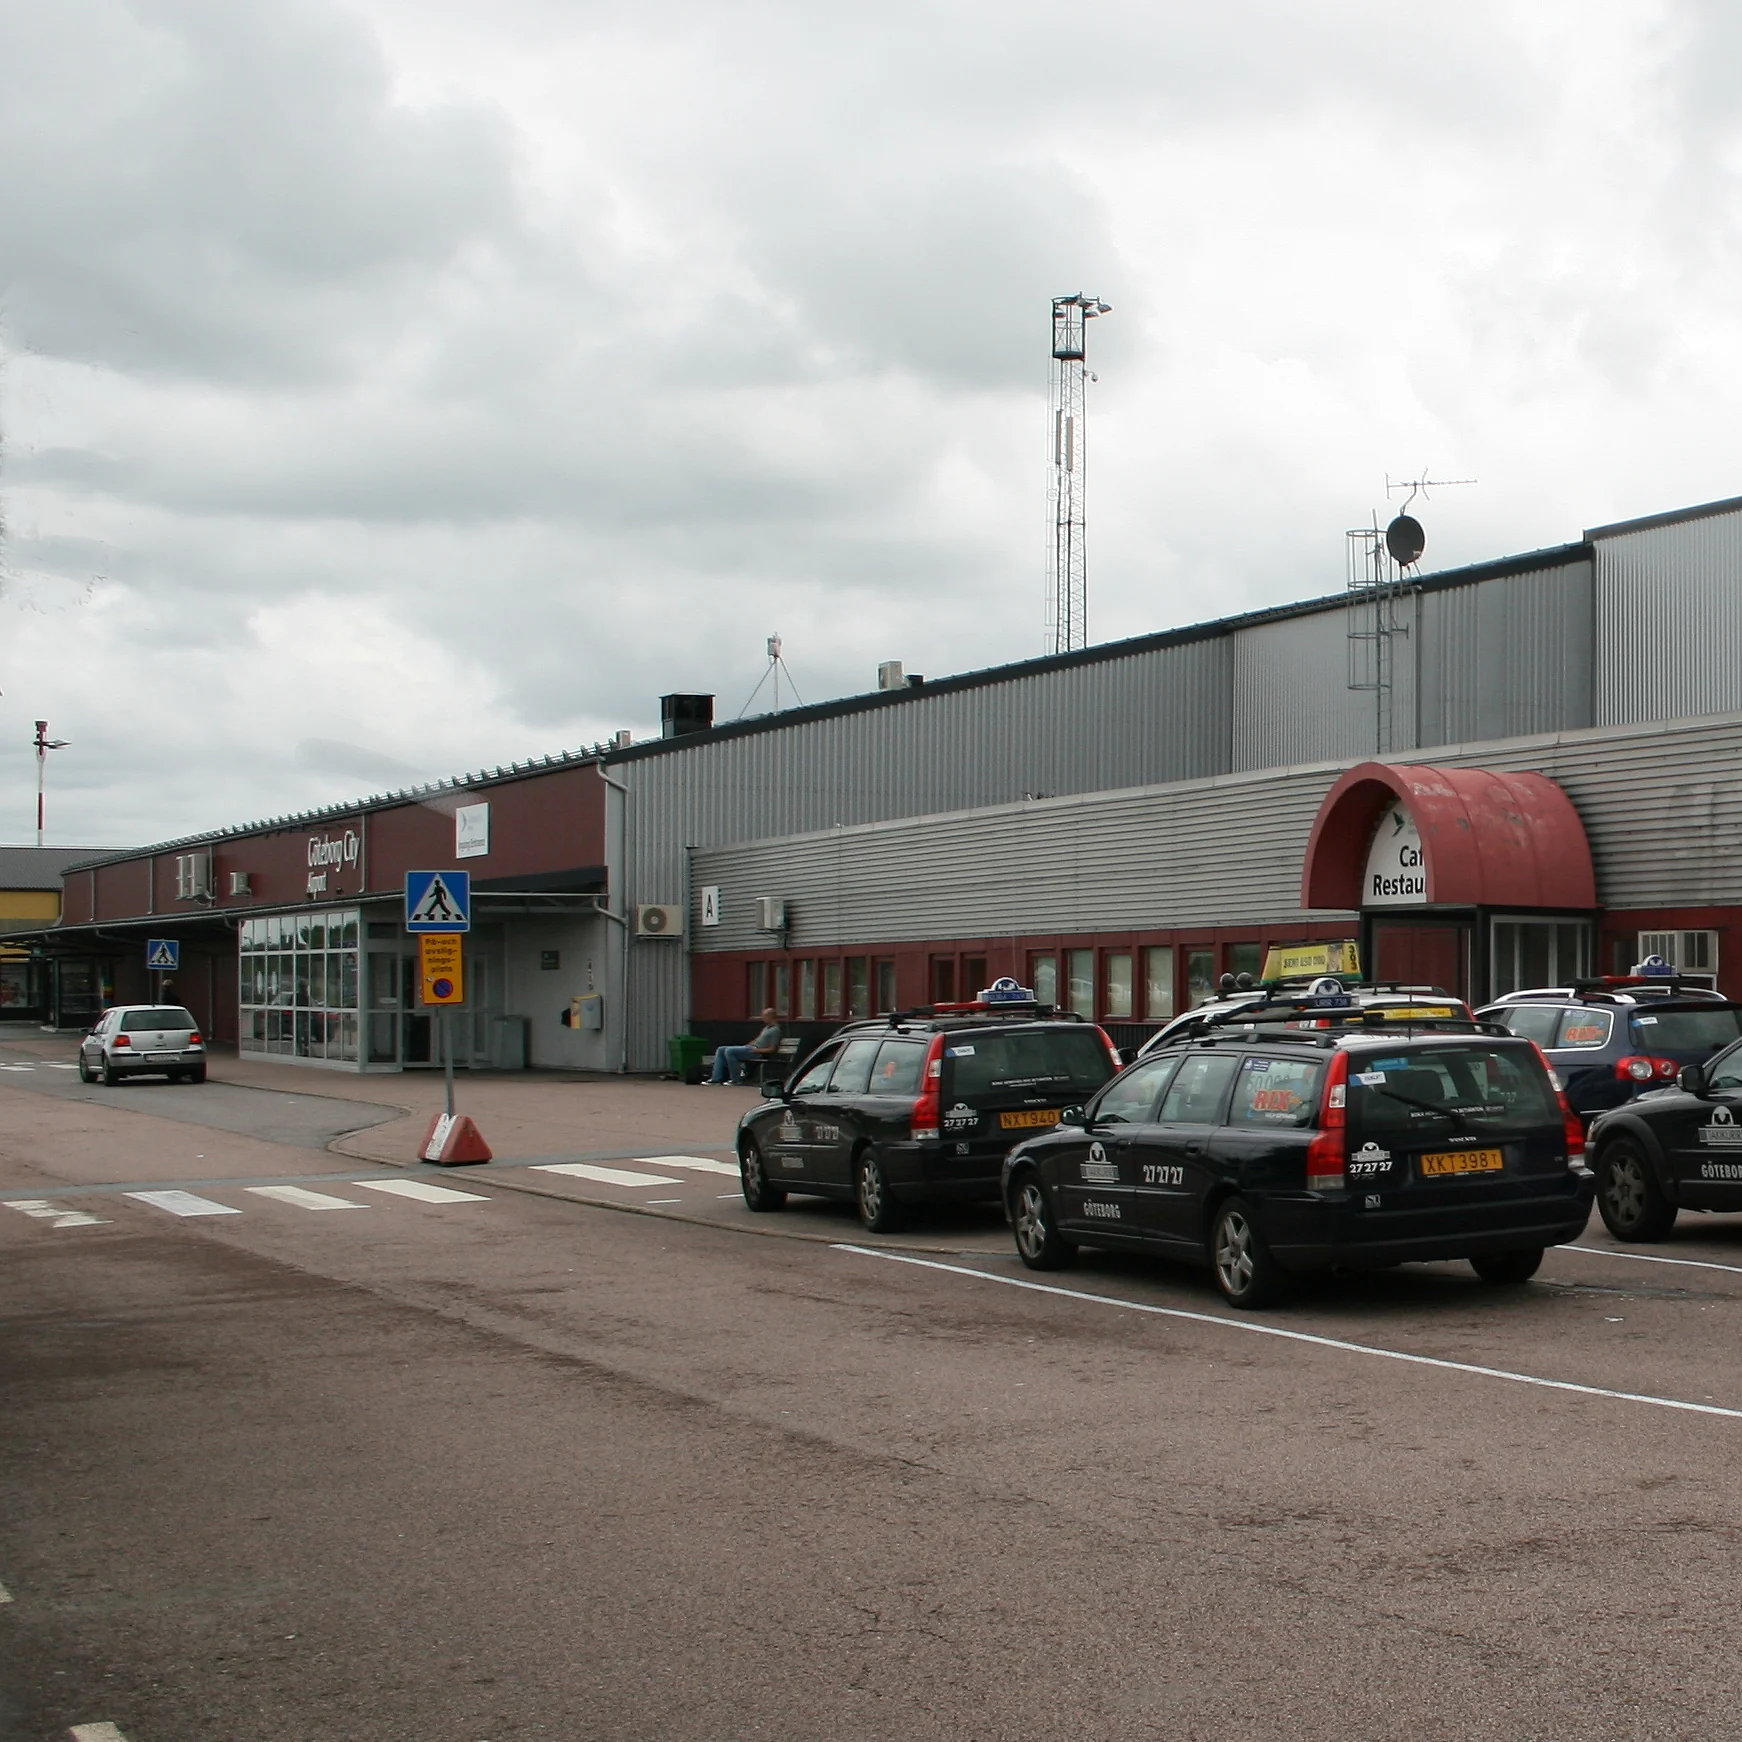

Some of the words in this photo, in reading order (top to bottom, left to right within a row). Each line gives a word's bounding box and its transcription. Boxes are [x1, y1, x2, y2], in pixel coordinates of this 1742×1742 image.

[706, 893, 714, 918] A
[1143, 1165, 1156, 1183] 27
[1156, 1165, 1169, 1184] 27
[1170, 1166, 1184, 1185] 27
[1349, 1163, 1363, 1174] 27
[1364, 1162, 1379, 1173] 27
[1379, 1161, 1393, 1172] 27
[1083, 1199, 1121, 1219] GÖTEBORG
